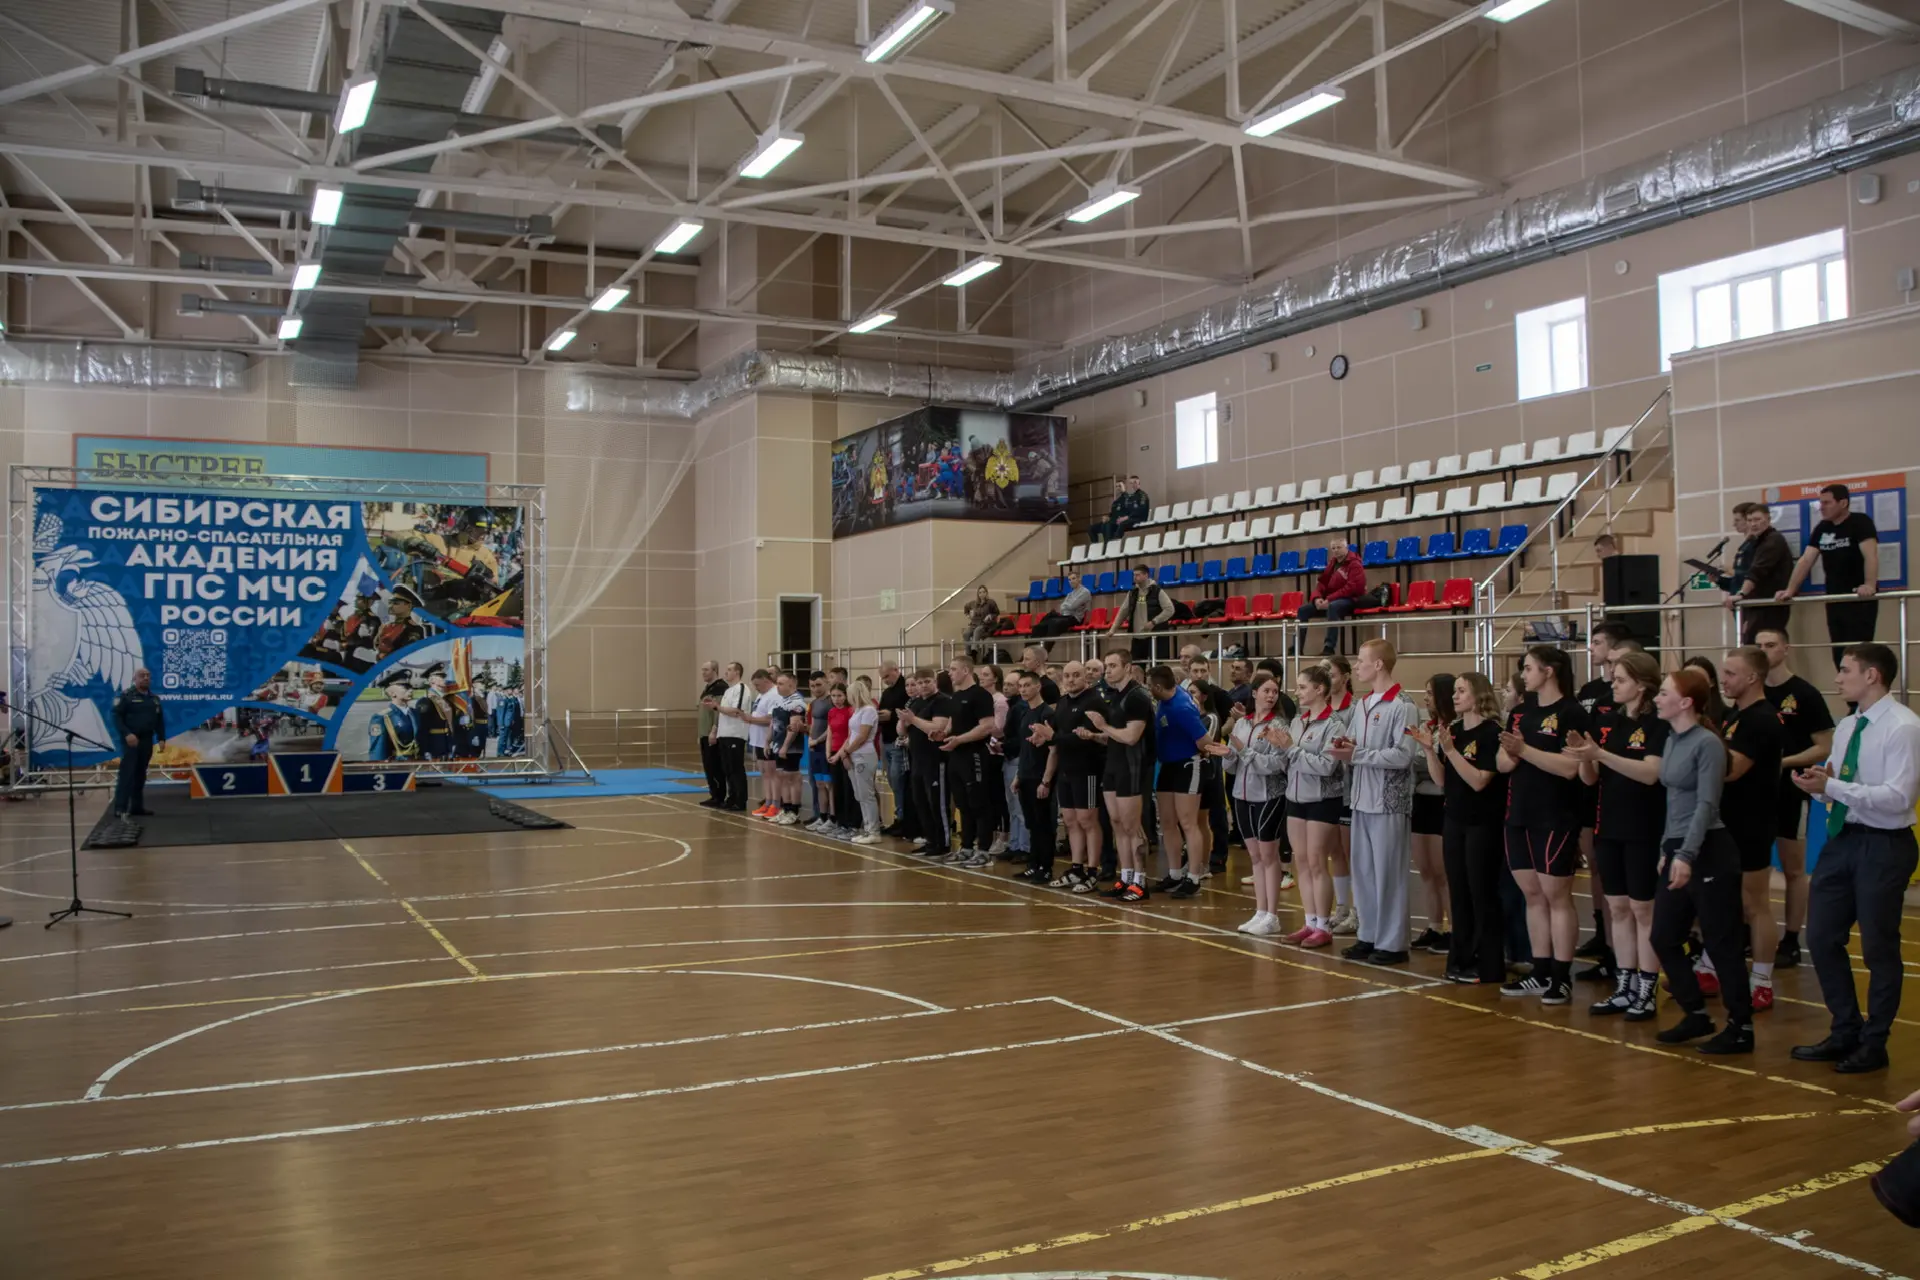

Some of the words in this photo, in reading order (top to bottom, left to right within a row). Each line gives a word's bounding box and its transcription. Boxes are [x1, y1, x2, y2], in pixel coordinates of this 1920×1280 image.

[90, 496, 352, 530] СИБИРСКАЯ
[88, 526, 343, 547] ПОЖАРНО-СПАСАТЕЛЬНАЯ
[125, 543, 338, 573] АКАДЕМИЯ
[144, 573, 225, 600] ГПС
[238, 575, 326, 602] МЧС
[161, 605, 302, 627] РОССИИ
[222, 772, 236, 790] 2
[300, 764, 312, 782] 1
[373, 774, 386, 791] 3
